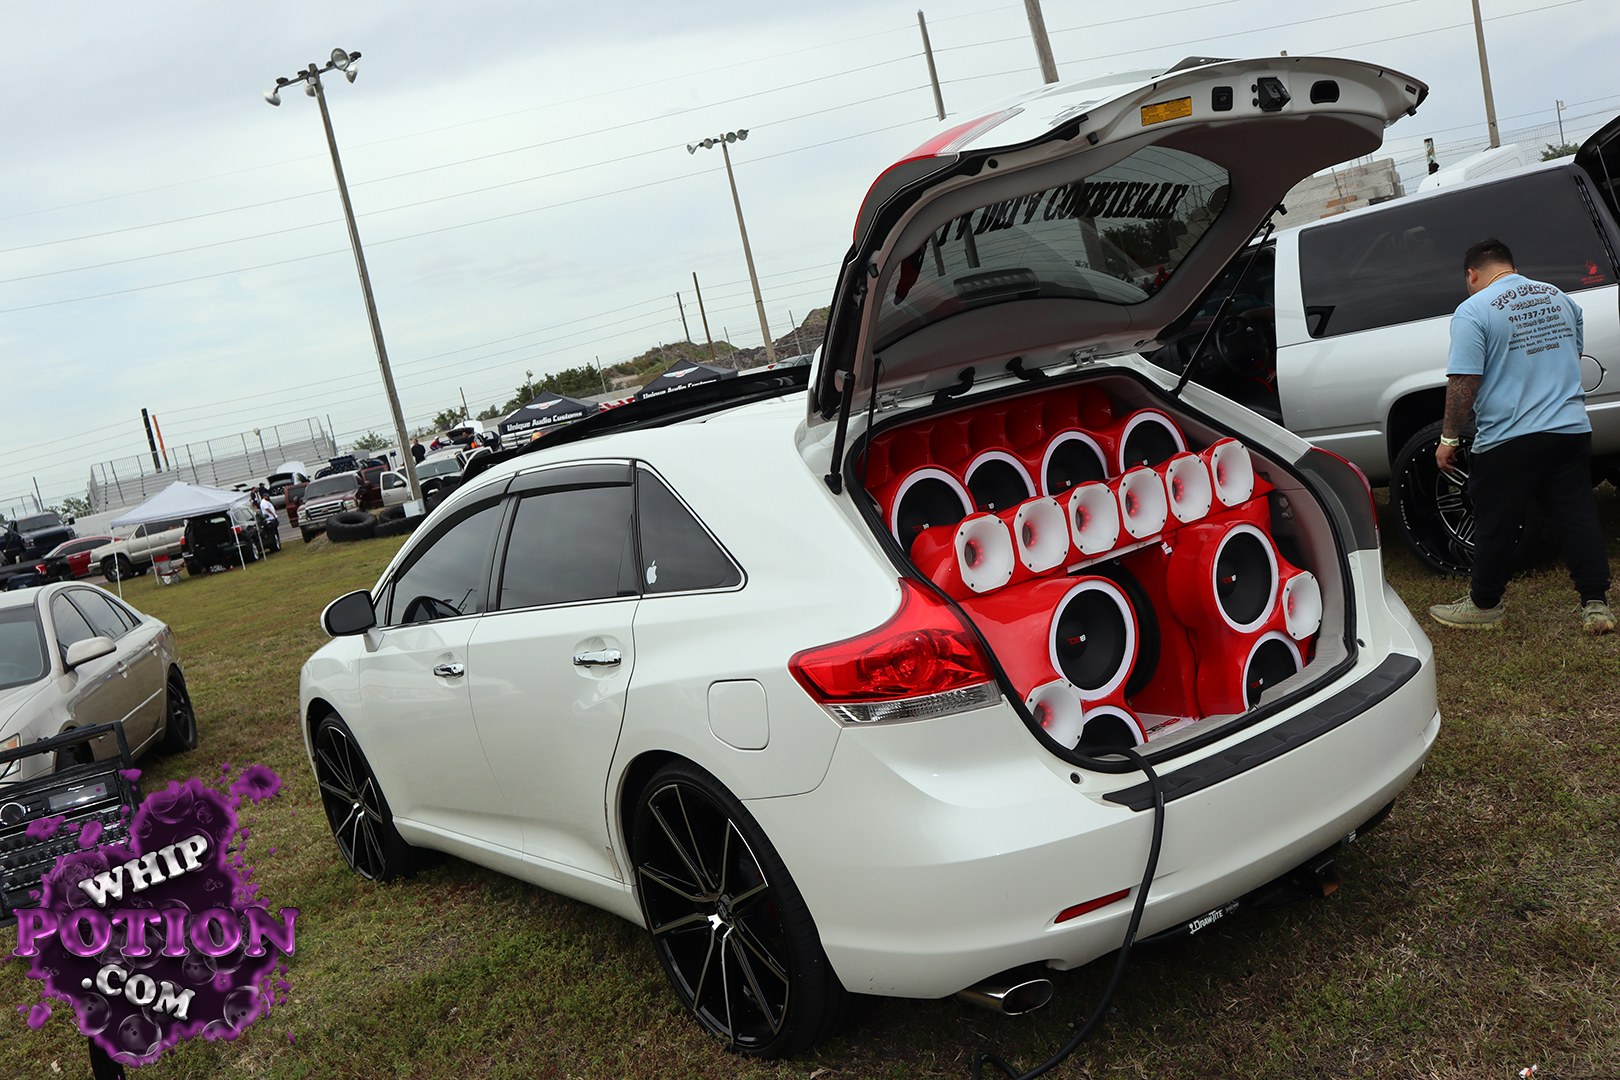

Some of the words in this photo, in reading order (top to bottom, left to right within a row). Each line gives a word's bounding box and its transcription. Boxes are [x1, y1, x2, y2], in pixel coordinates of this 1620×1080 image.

[1490, 289, 1517, 310] Pro
[1508, 305, 1562, 323] 941-737-7160
[506, 421, 531, 432] Unique
[531, 415, 552, 427] Audio
[552, 411, 583, 422] Customs
